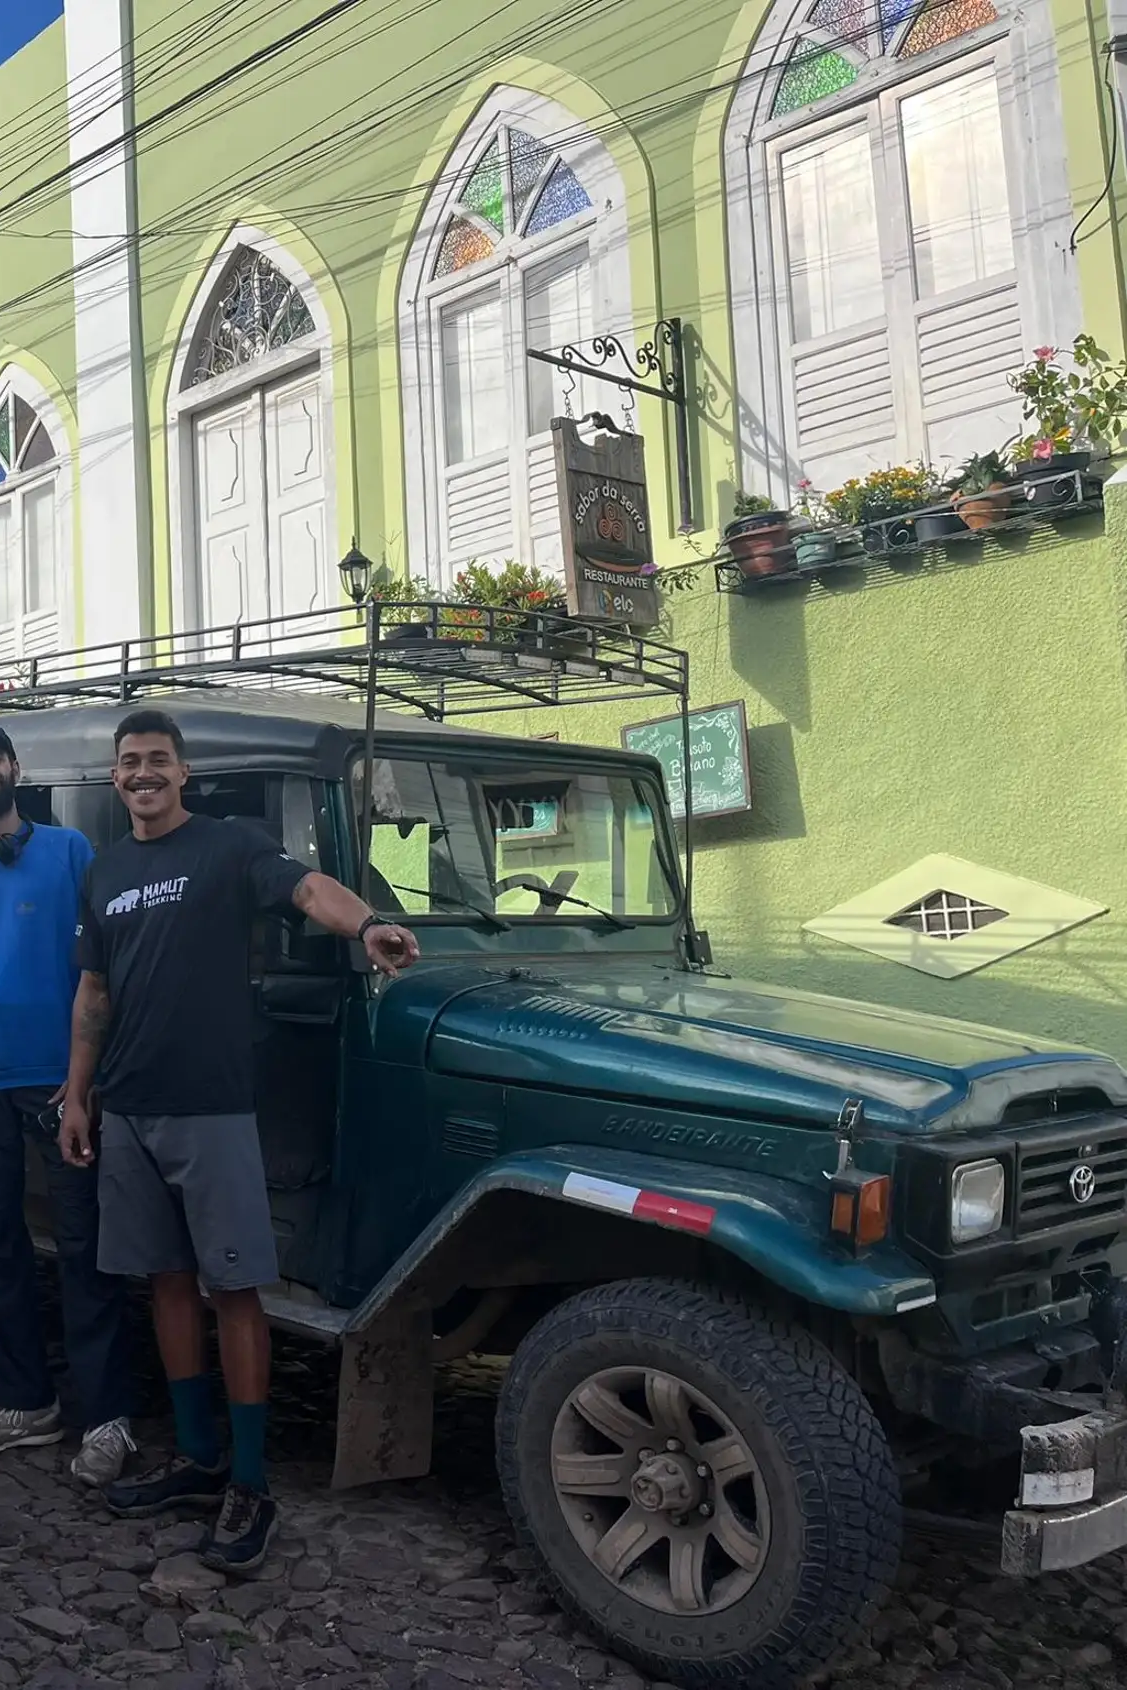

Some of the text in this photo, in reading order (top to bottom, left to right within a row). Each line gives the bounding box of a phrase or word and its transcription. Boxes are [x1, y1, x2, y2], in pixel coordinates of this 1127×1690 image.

[602, 480, 618, 500] da
[619, 495, 646, 533] serra
[583, 567, 649, 589] RESTAURANTE
[143, 876, 189, 901] MAMUT
[143, 893, 182, 909] TREKKING
